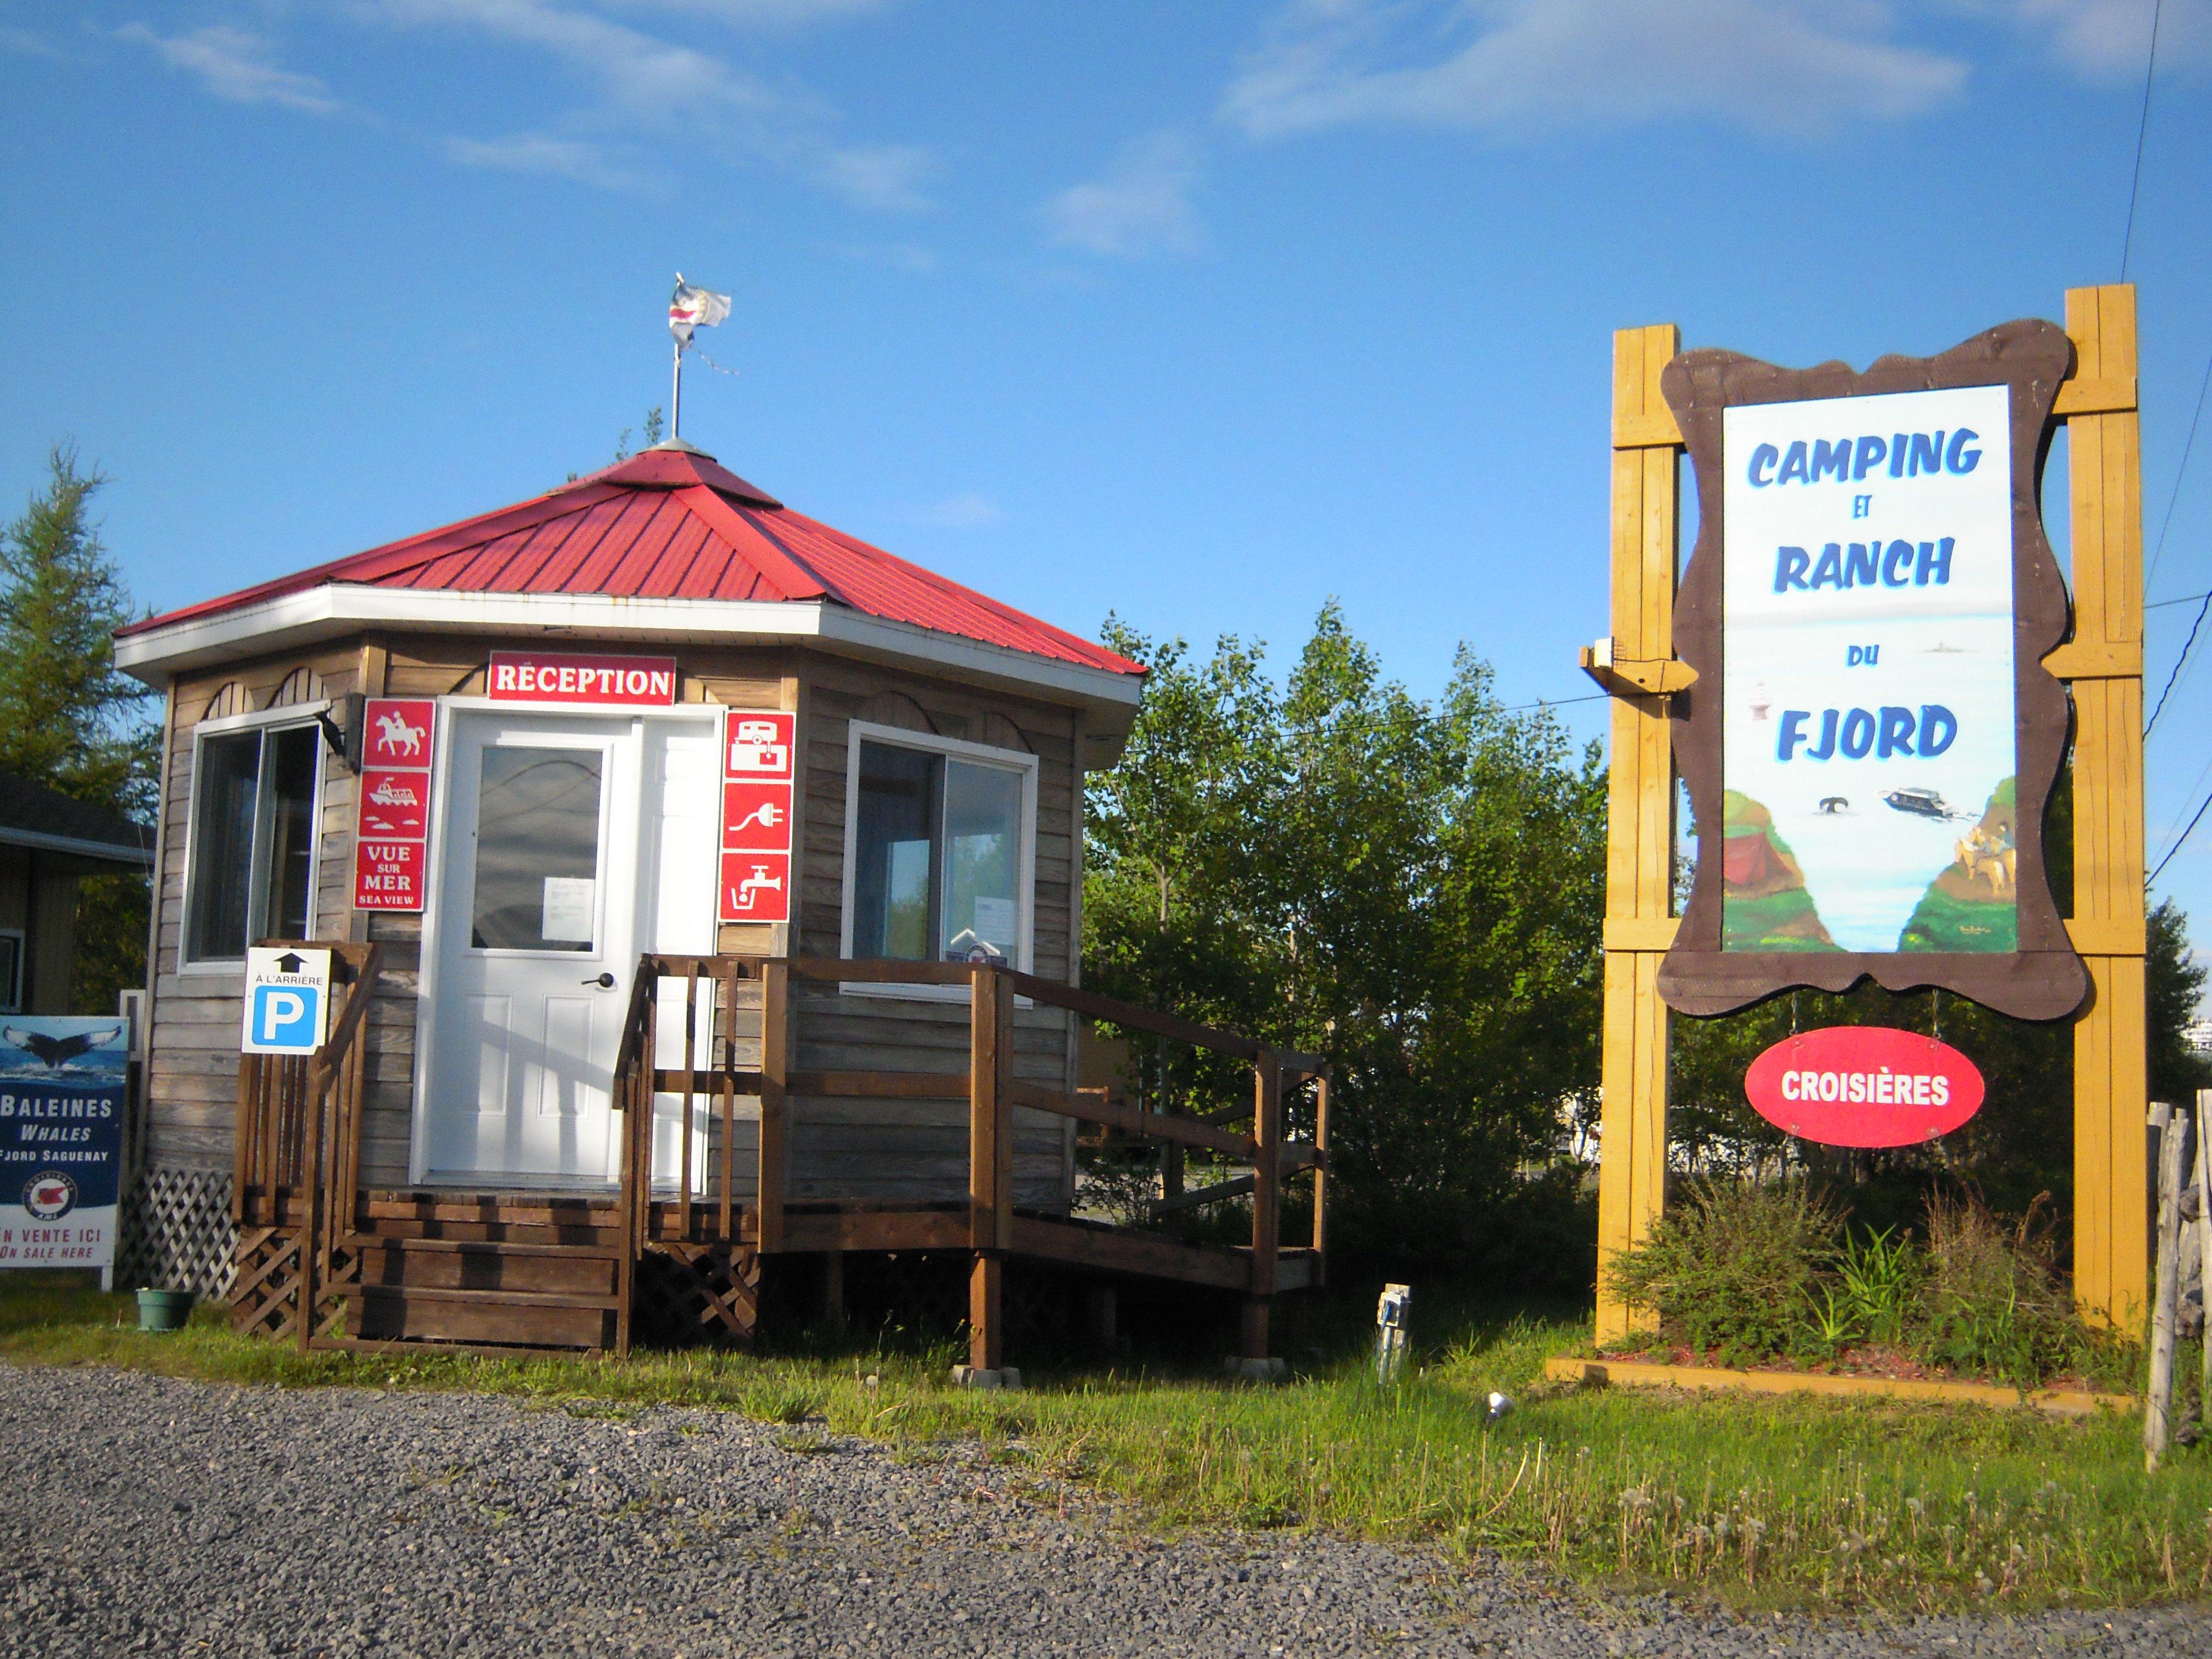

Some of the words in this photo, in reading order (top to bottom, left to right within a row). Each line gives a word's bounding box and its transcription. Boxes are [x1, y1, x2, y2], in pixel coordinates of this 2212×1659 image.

[1746, 427, 1983, 488] CAMPING
[1851, 494, 1872, 519] ET
[1772, 537, 1955, 595] RANCH
[1845, 645, 1879, 668] DU
[1775, 705, 1957, 764] FJORD
[368, 846, 410, 861] VUE
[377, 864, 400, 873] SUR
[364, 875, 411, 890] MER
[359, 895, 381, 904] SEA
[384, 896, 414, 905] VIEW
[264, 992, 305, 1040] P
[1781, 1066, 1949, 1106] CROISIÈRES
[1, 1095, 112, 1118] BALEINES
[21, 1124, 91, 1141] WHALES
[43, 1150, 108, 1161] SAGUENAY
[23, 1229, 70, 1243] VENTE
[80, 1229, 100, 1243] ICI
[0, 1245, 17, 1258] ON
[24, 1247, 55, 1258] SALE
[61, 1247, 93, 1259] HERE
